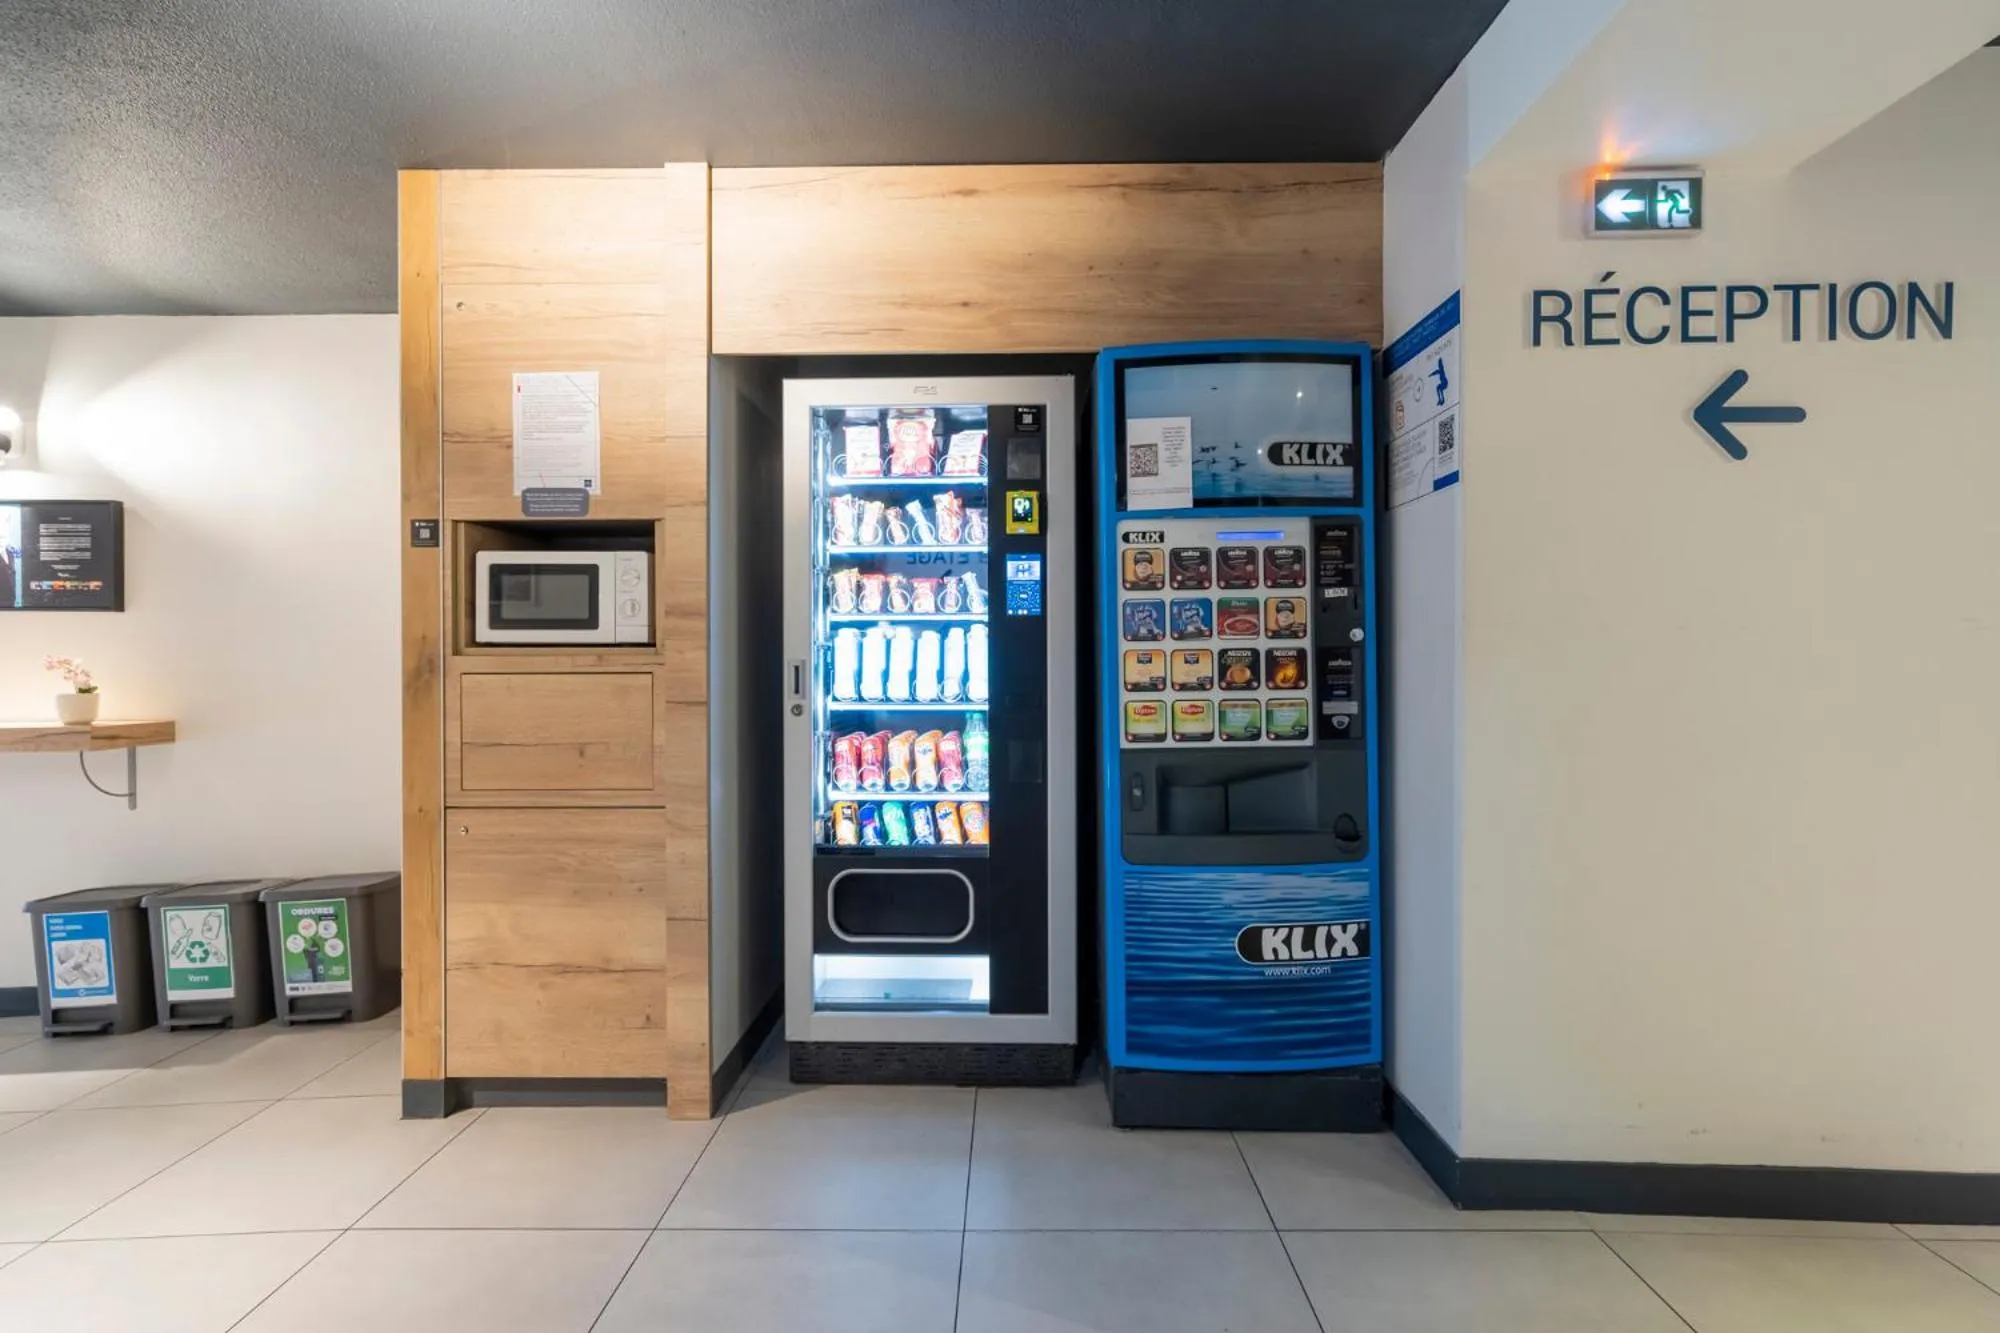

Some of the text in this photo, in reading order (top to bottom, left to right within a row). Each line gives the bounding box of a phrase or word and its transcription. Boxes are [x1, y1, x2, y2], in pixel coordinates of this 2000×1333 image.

[1532, 271, 1954, 347] RÉCEPTION
[1282, 443, 1345, 465] KLIX
[1129, 532, 1161, 543] KLIX
[1261, 923, 1360, 960] KLIX
